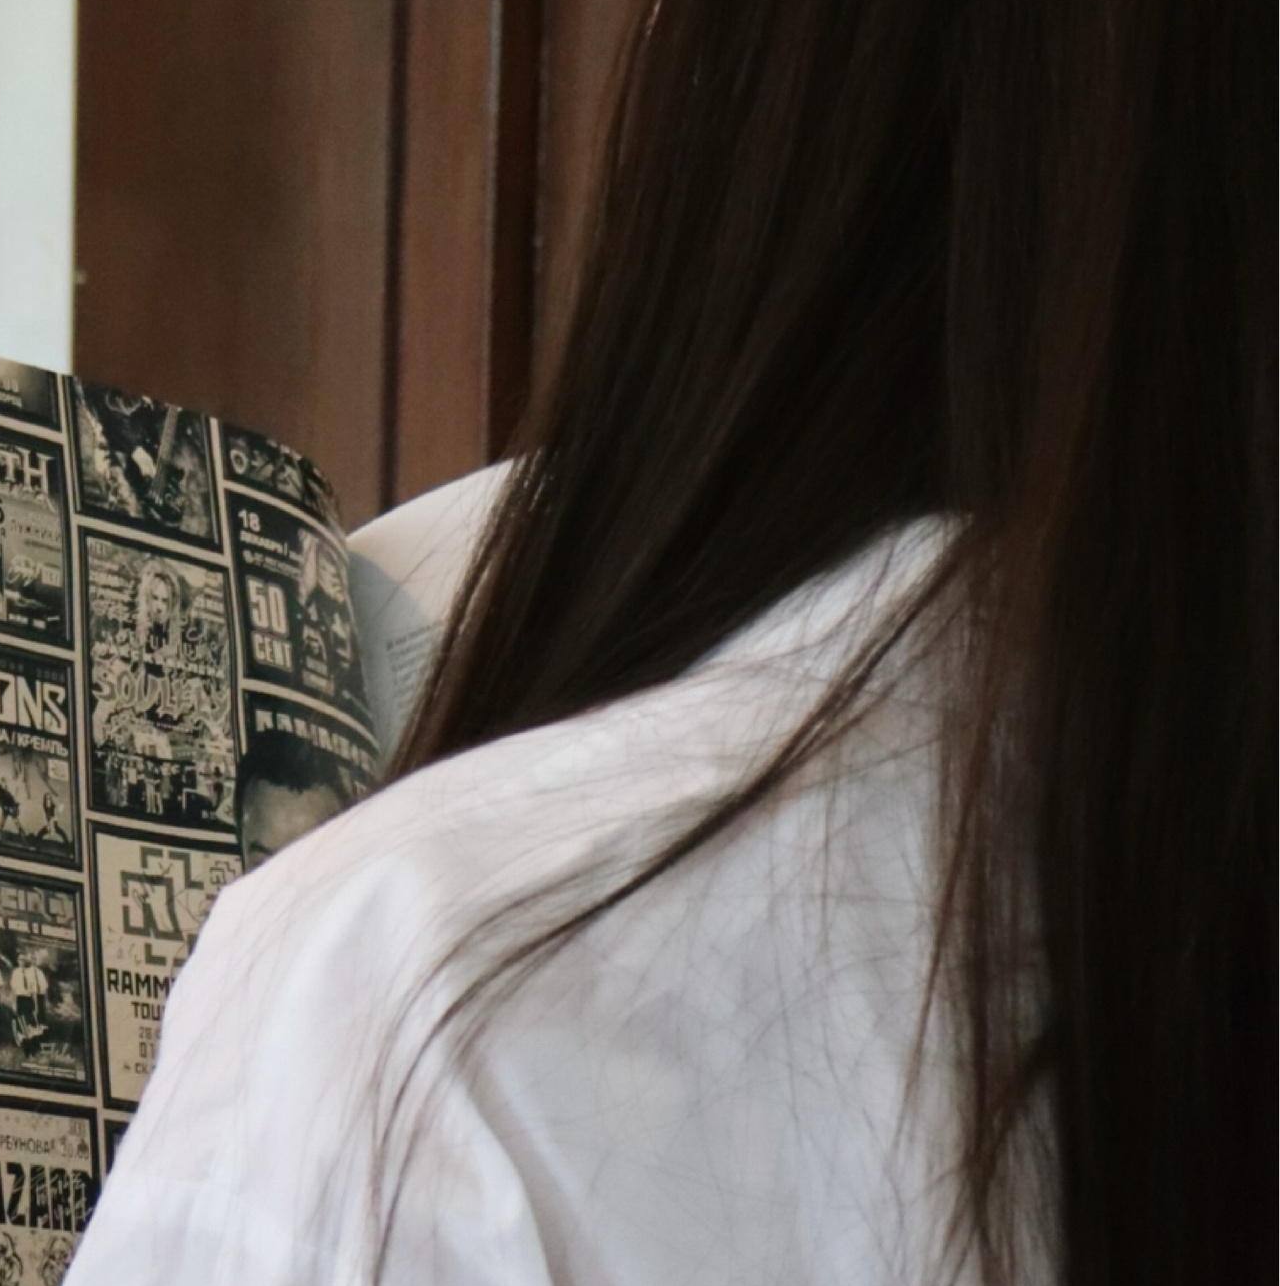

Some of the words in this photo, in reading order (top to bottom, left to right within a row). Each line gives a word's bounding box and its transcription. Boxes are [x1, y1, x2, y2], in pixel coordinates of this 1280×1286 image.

[238, 509, 261, 532] 18
[247, 577, 288, 635] 50
[251, 632, 293, 673] CENT
[17, 733, 69, 758] КРЕМЛЬ
[106, 967, 177, 1001] RAMM
[130, 1000, 165, 1022] TOU
